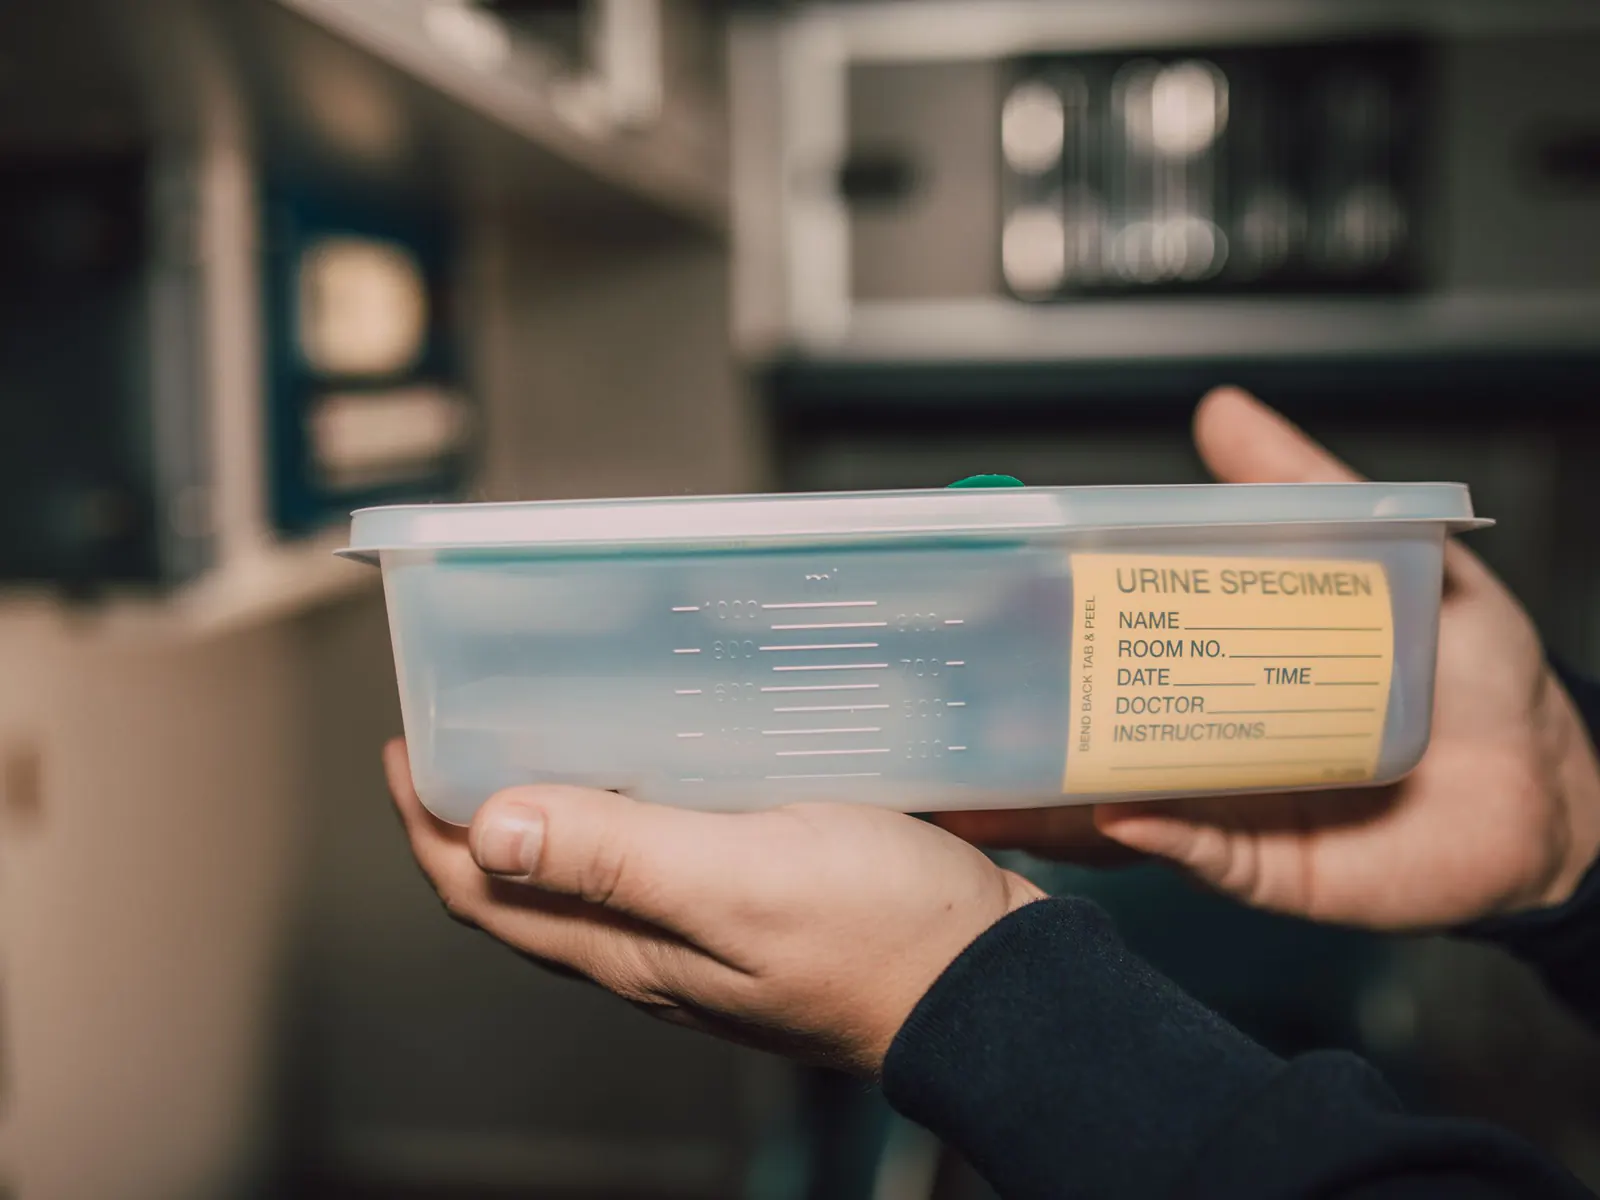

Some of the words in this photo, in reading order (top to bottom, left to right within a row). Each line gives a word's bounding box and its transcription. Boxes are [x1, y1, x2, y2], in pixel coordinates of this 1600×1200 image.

[804, 567, 839, 588] m
[1116, 568, 1211, 594] URINE
[1219, 569, 1372, 596] SPECIMEN
[1085, 595, 1096, 629] PEEL
[1118, 611, 1180, 629] NAME
[1084, 633, 1095, 642] &
[1083, 645, 1094, 669] TAB
[1118, 639, 1183, 658] ROOM
[1190, 639, 1226, 658] NO.
[1116, 668, 1171, 686] DATE
[1263, 667, 1312, 685] TIME
[1082, 675, 1093, 711] BACK
[1115, 696, 1205, 715] DOCTOR
[1079, 715, 1091, 752] BEND
[1113, 722, 1266, 743] INSTRUCTIONS
